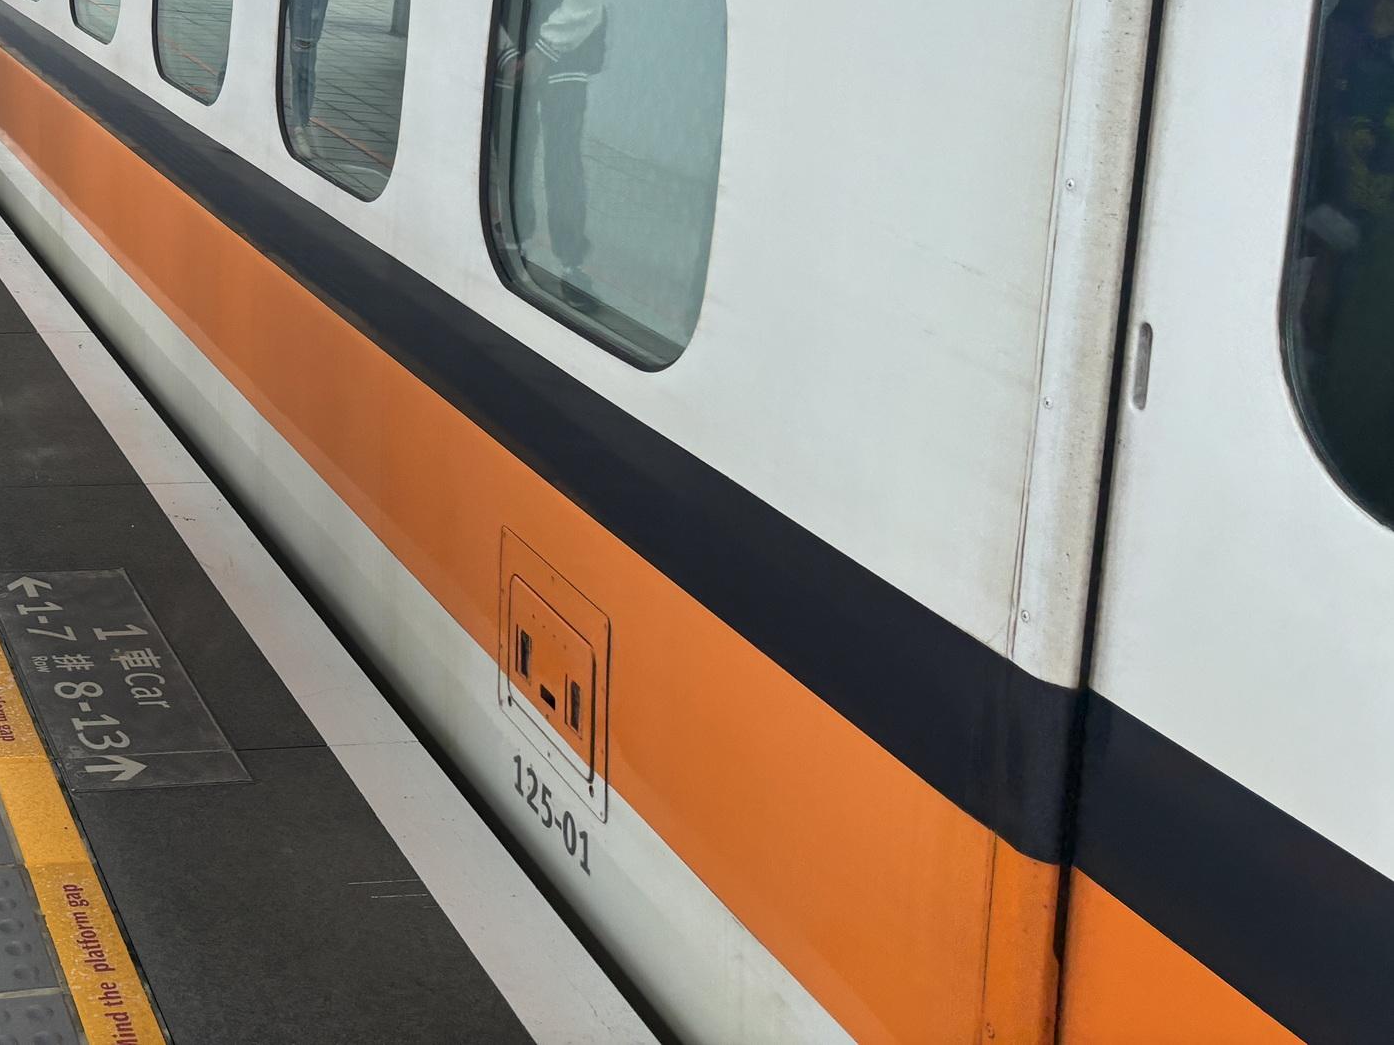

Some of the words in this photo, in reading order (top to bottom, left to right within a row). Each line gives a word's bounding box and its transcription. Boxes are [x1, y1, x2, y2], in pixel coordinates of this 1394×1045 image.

[31, 656, 51, 673] Row
[52, 654, 94, 672] 排
[513, 754, 591, 876] 125-01
[63, 883, 89, 907] gap
[73, 911, 116, 973] platform
[98, 981, 124, 1007] the
